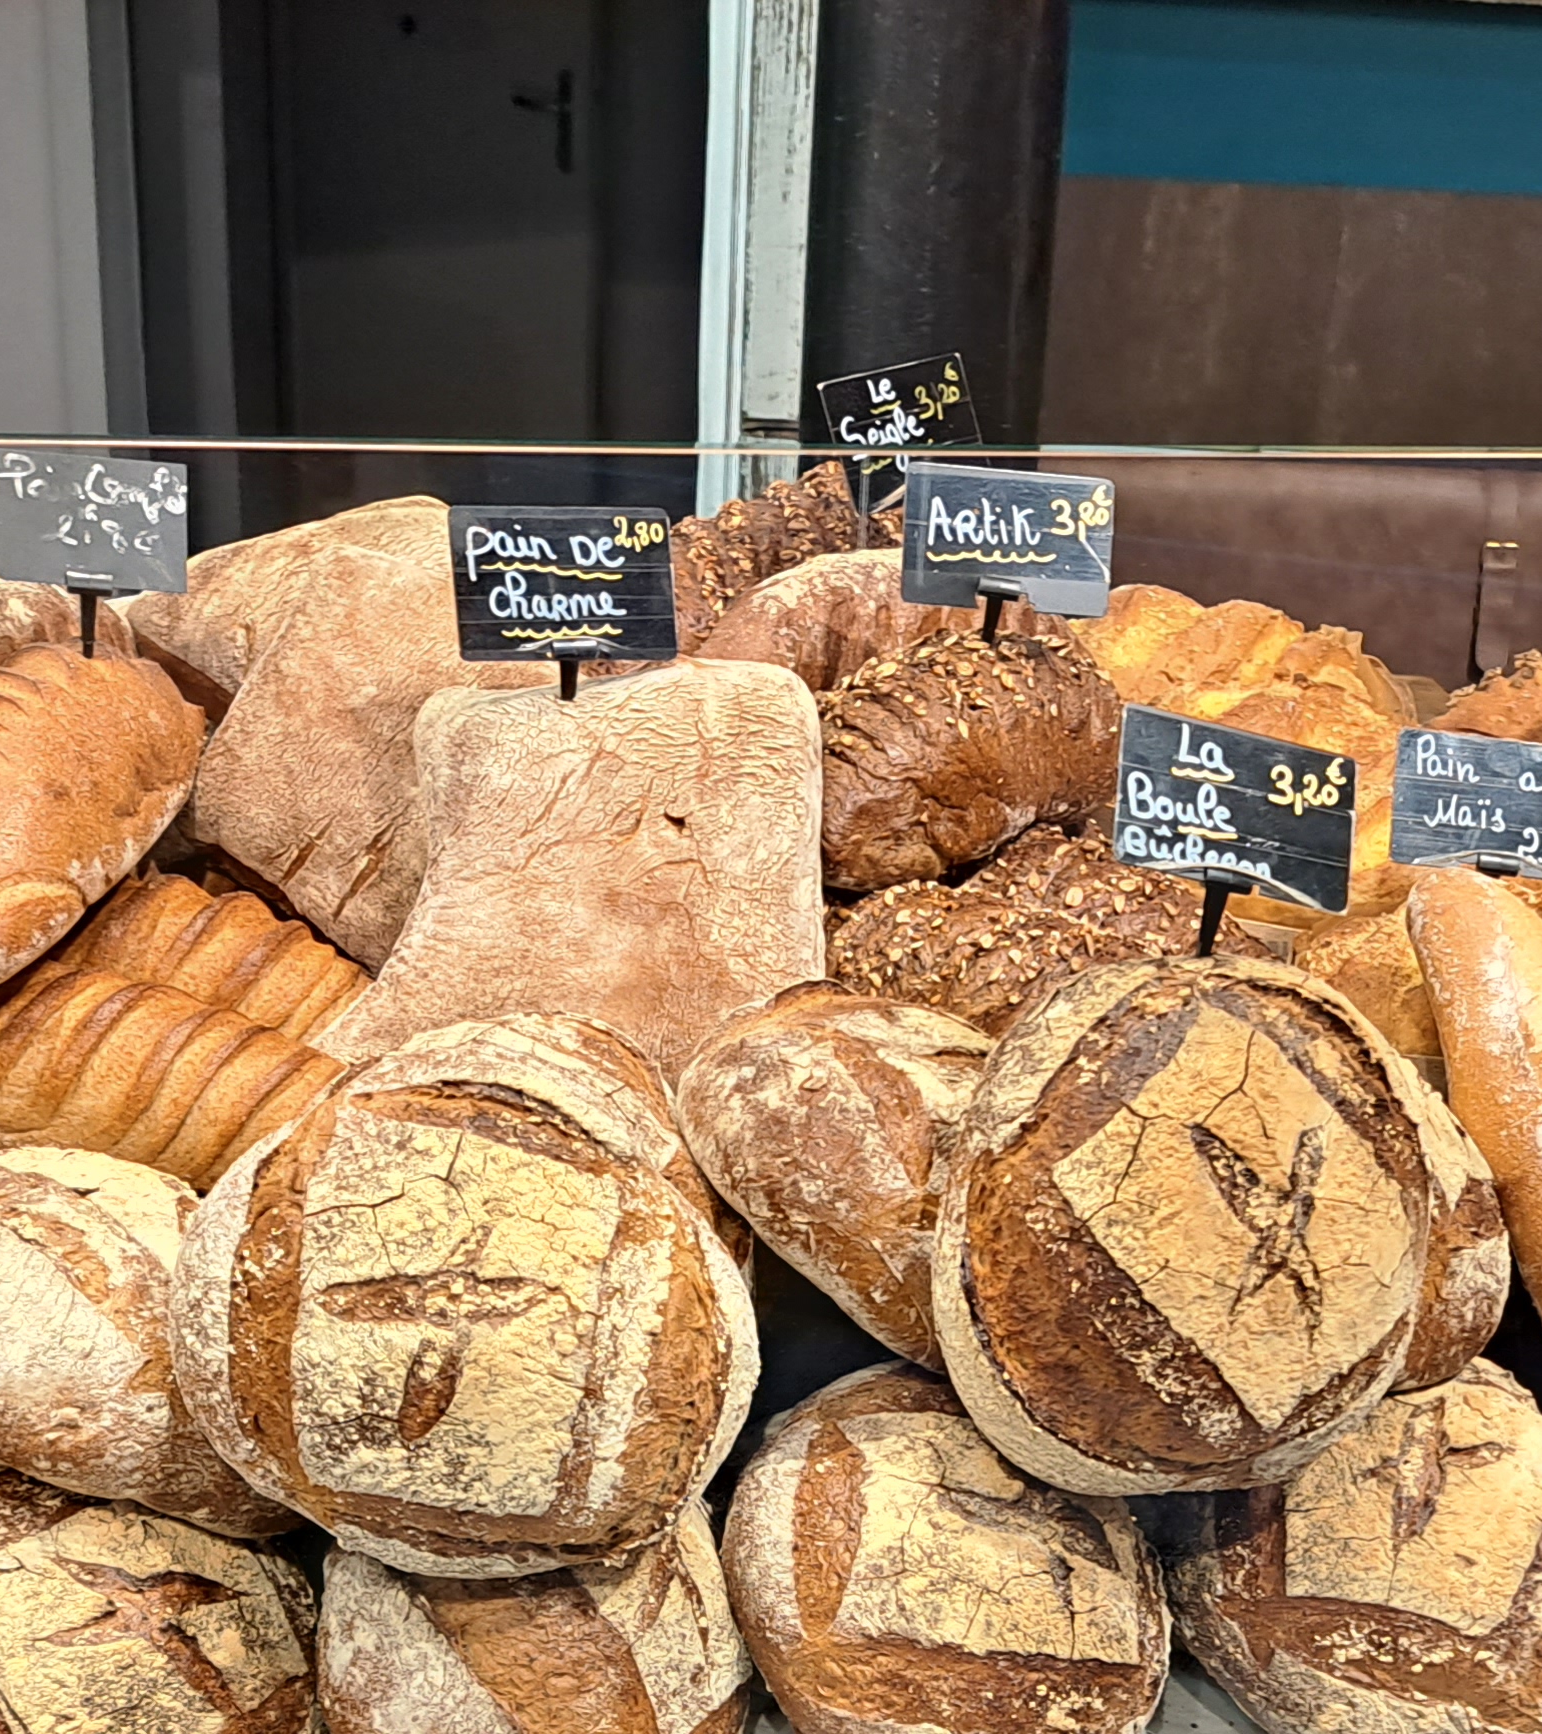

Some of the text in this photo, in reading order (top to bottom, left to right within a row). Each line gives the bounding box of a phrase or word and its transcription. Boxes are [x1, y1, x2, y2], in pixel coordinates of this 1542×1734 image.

[866, 377, 897, 404] Le
[1178, 722, 1235, 779] La
[1416, 733, 1481, 784] Pain
[1127, 770, 1237, 833] Boule
[1422, 794, 1507, 833] Maïs
